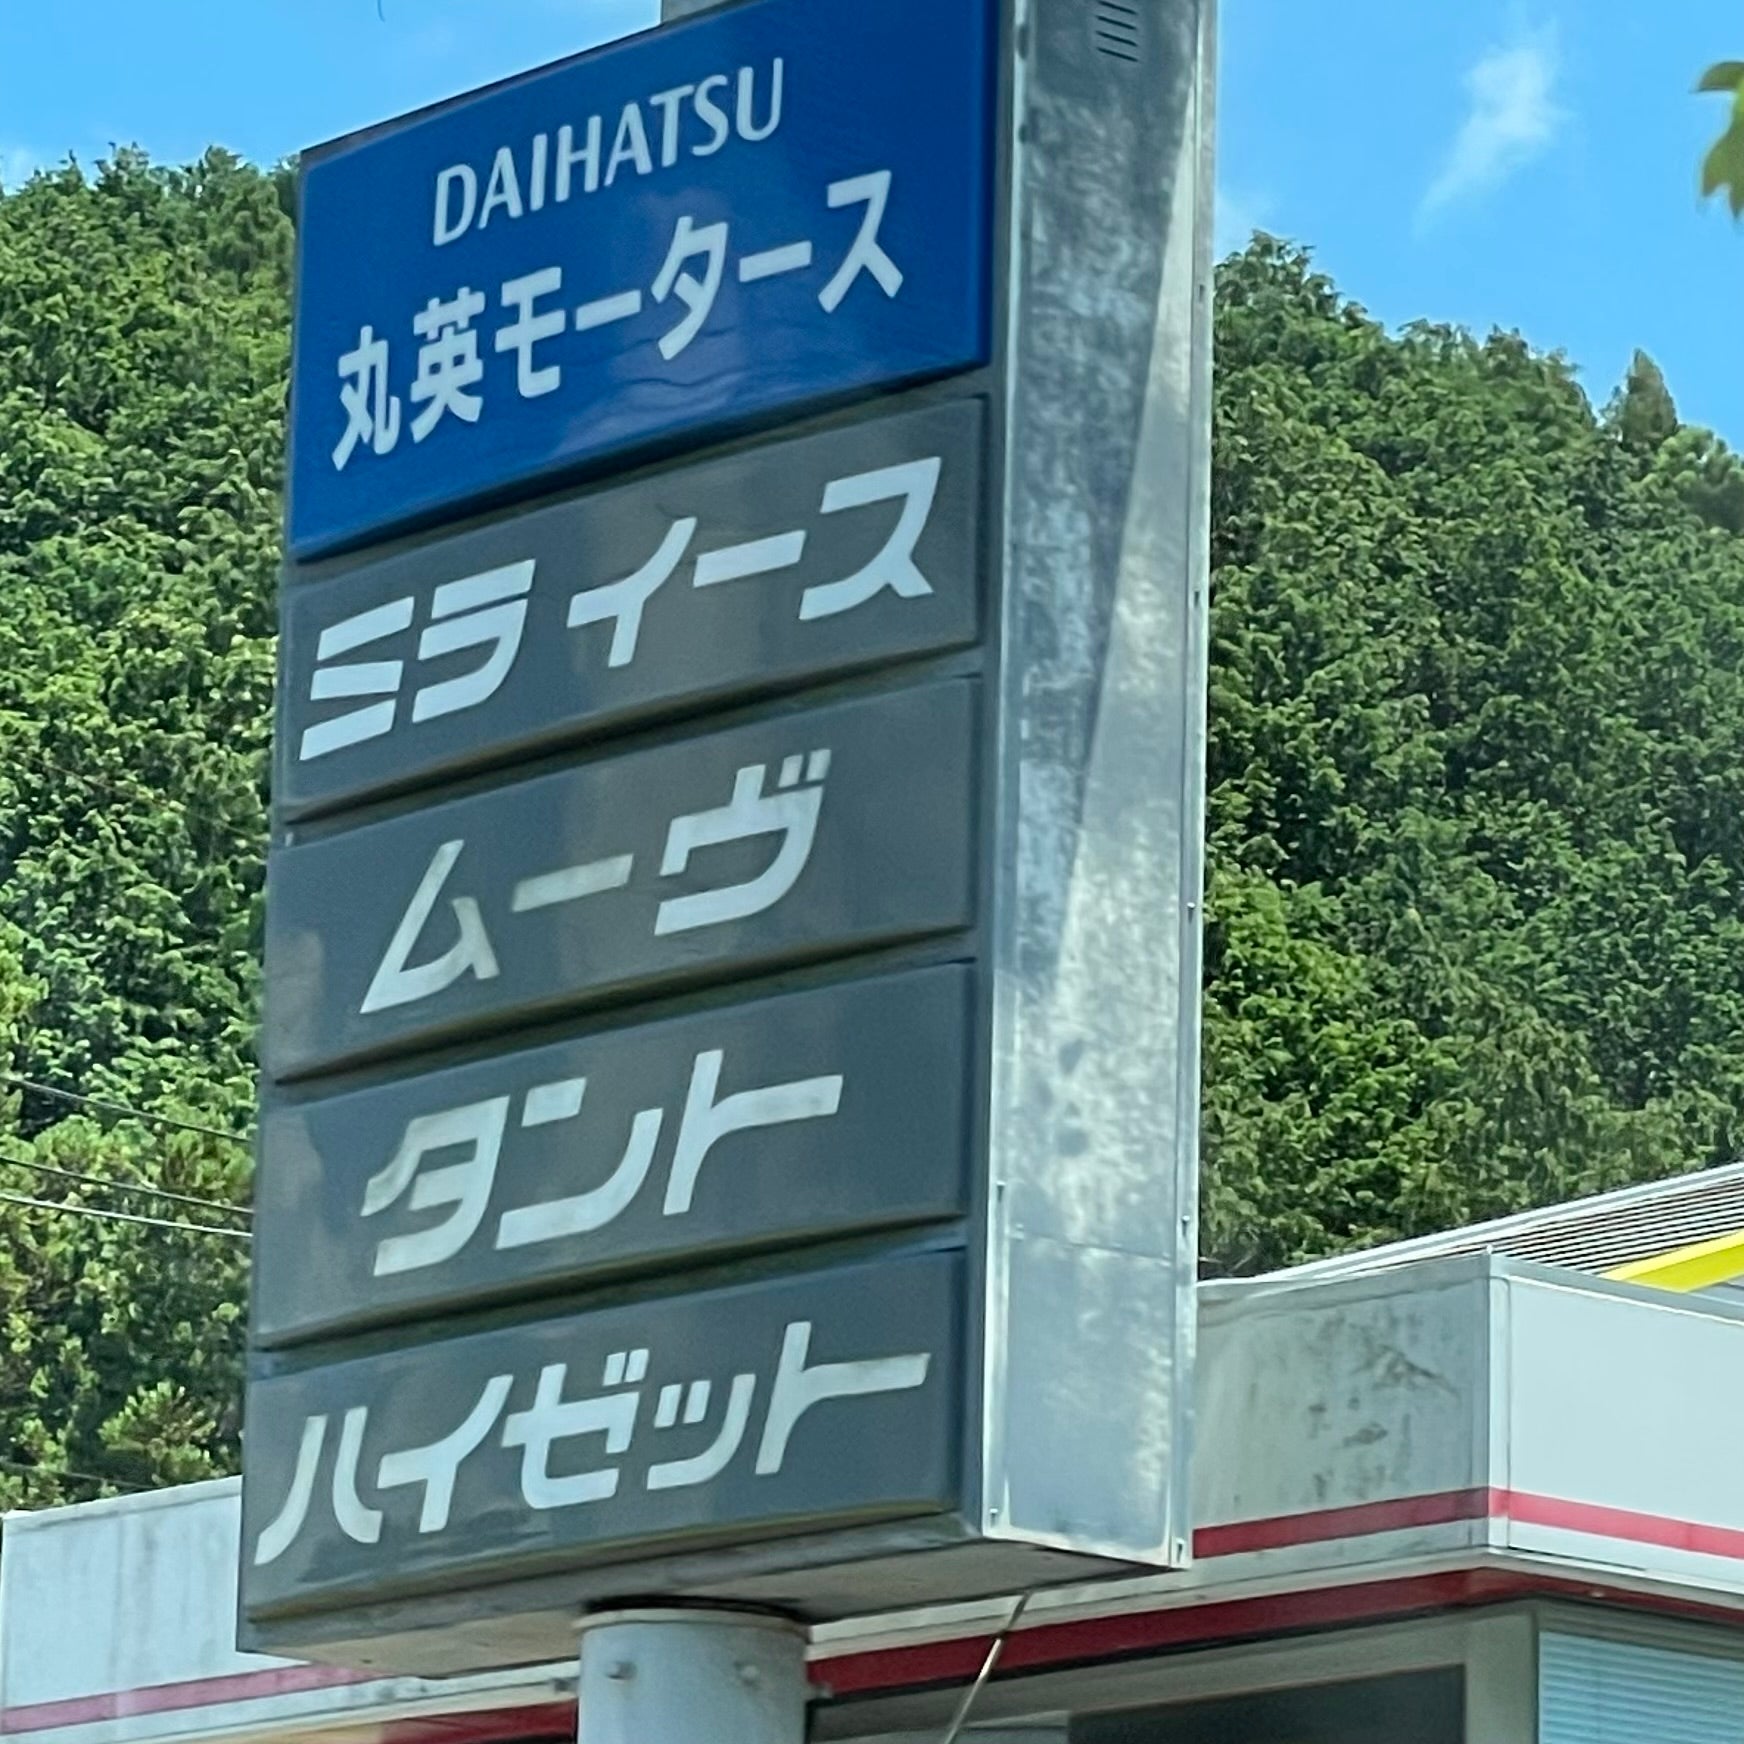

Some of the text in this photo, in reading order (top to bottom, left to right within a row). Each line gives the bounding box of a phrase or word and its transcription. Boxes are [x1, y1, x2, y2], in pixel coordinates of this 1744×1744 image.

[432, 57, 785, 247] DAIHATSU
[331, 169, 904, 472] 丸英モータース
[299, 455, 941, 763] ミライース
[360, 747, 832, 1015] ムーヴ
[360, 1048, 845, 1278] タント
[254, 1320, 931, 1567] ハイゼット
